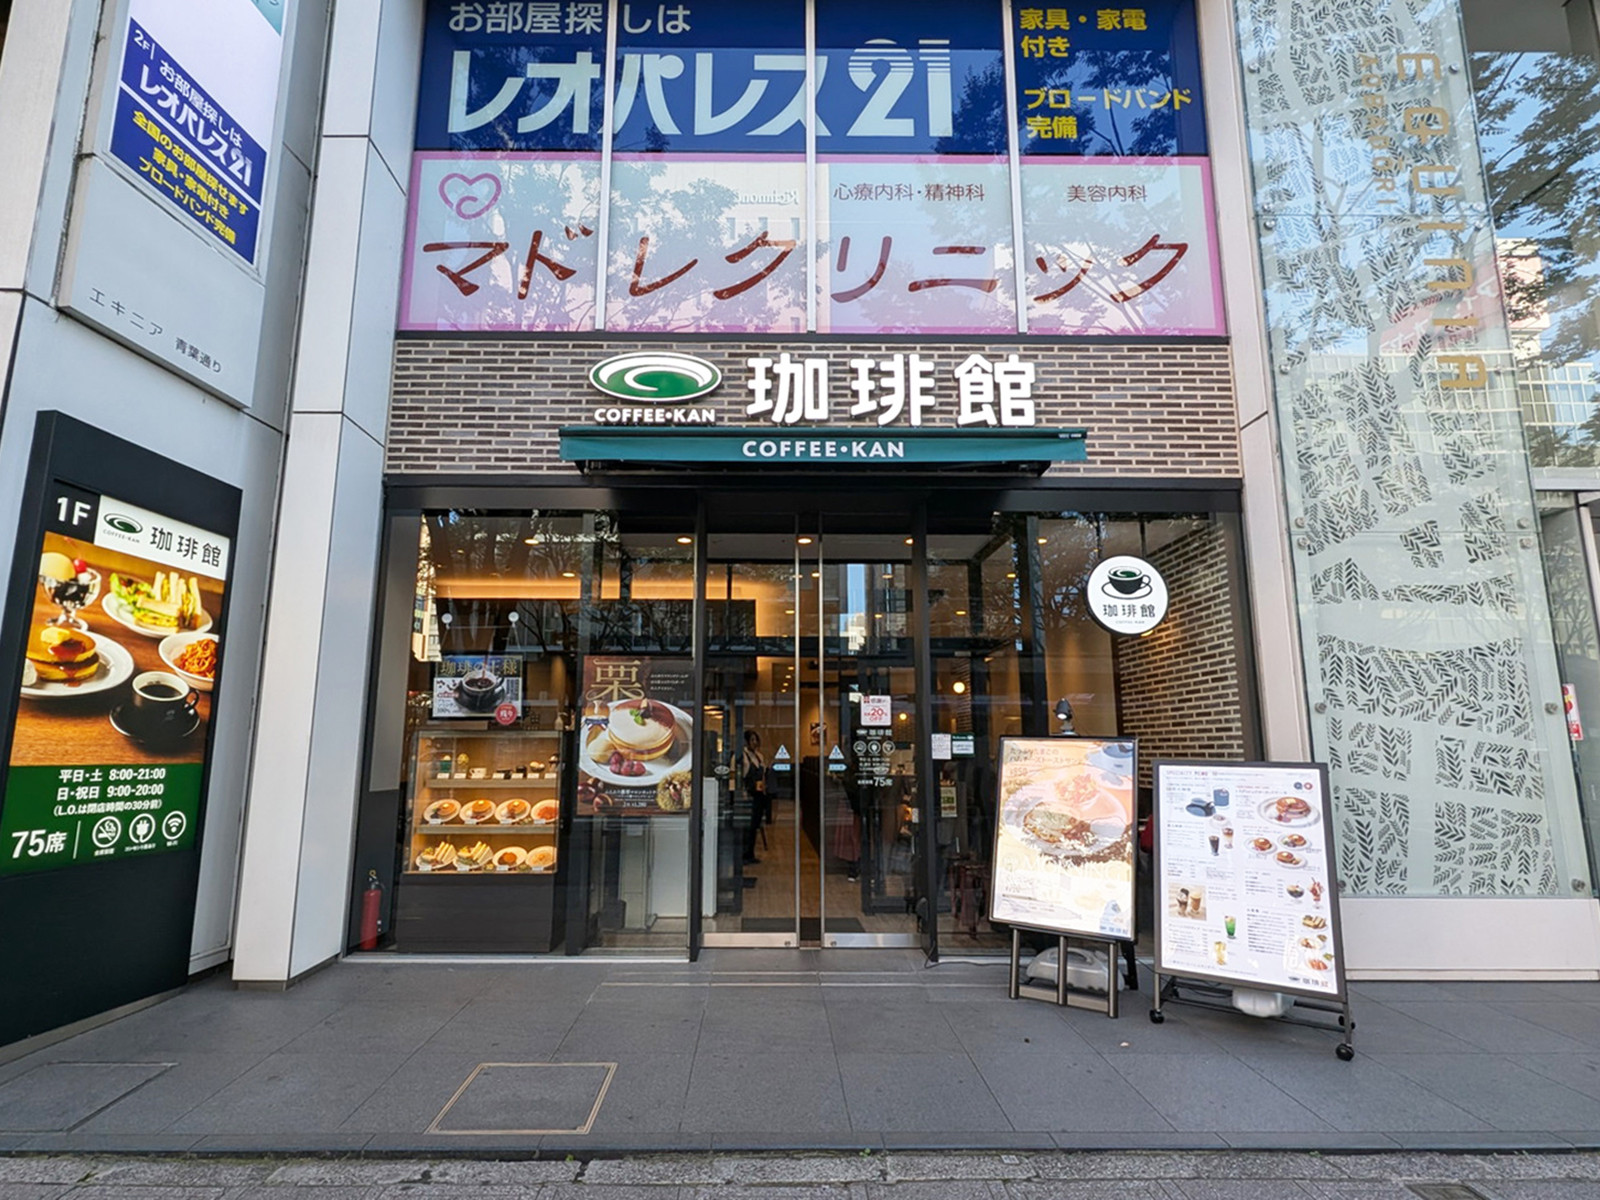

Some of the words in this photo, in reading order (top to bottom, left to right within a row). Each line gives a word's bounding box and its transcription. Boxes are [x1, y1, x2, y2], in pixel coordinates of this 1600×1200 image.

[448, 2, 692, 35] お部屋探しは
[1019, 8, 1148, 31] 家具・家電
[134, 29, 151, 52] 2F
[1021, 35, 1070, 58] 付き
[158, 59, 243, 147] お部屋探しは
[447, 37, 953, 138] レオパレス21
[1023, 87, 1192, 112] ブロードバンド
[140, 65, 253, 188] レオパレス21
[1026, 115, 1078, 140] 完備
[132, 110, 250, 217] 全国のお部屋探せます
[152, 147, 230, 220] 家具・家電付き
[833, 182, 985, 202] 心療内科・精神科
[1066, 184, 1147, 203] 美容内科
[138, 156, 237, 245] ブロードバンド完備
[1396, 53, 1488, 388] EQUINIA
[422, 223, 1189, 304] マドレクリニック
[88, 287, 164, 336] エキニア
[174, 337, 222, 374] 青葉通り
[745, 352, 1037, 427] 珈琲館
[56, 497, 91, 526] 1F
[149, 526, 222, 567] 珈琲館
[1102, 603, 1156, 618] 珈琲館
[585, 658, 645, 701] 栗
[58, 768, 104, 783] 平日・土
[109, 767, 166, 781] 8:00-21:00
[57, 785, 100, 801] 日・祝日
[107, 783, 164, 797] 9:00-20:00
[11, 829, 67, 859] 75席
